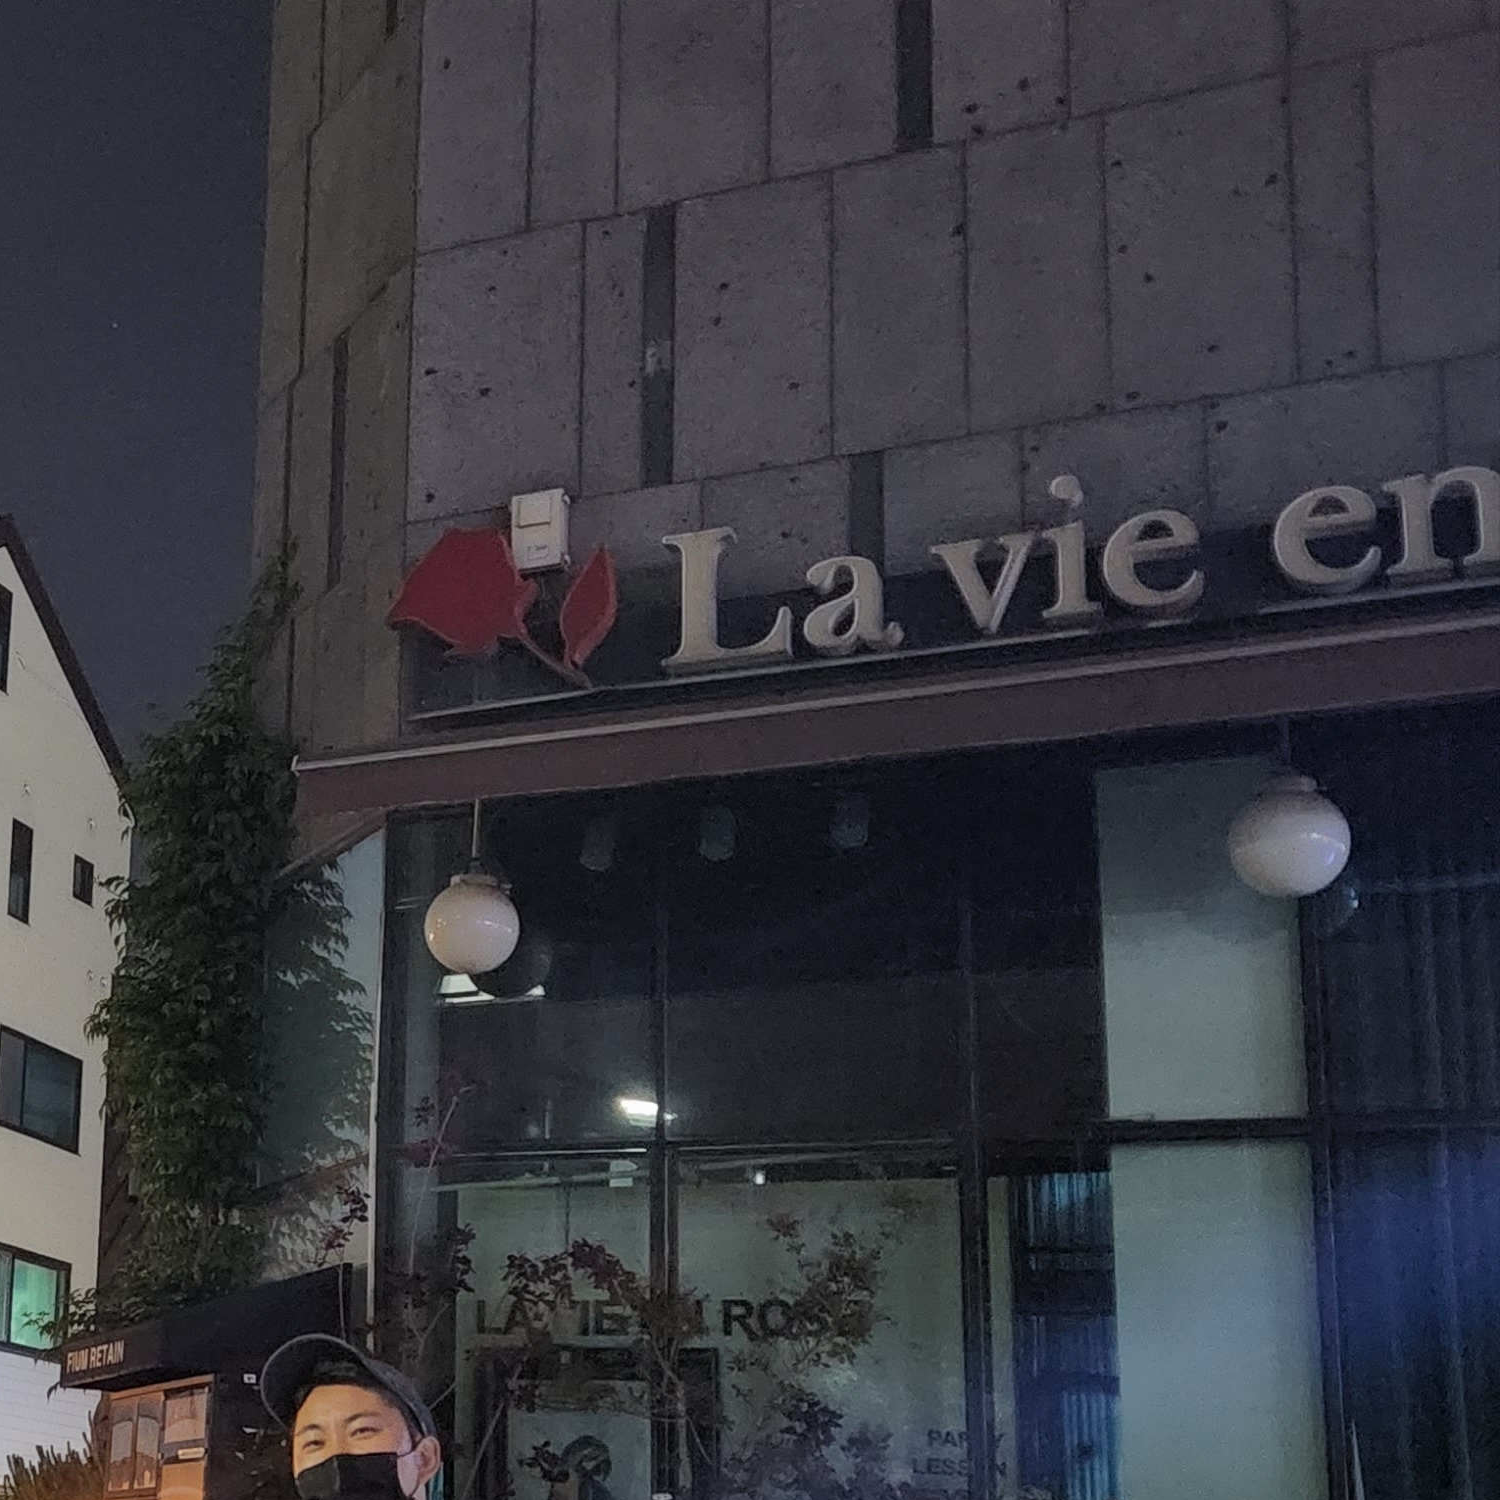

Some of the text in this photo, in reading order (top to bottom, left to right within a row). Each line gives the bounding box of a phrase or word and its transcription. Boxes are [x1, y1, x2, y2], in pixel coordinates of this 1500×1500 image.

[661, 464, 1500, 677] La vie en
[89, 1340, 125, 1369] RETAIN
